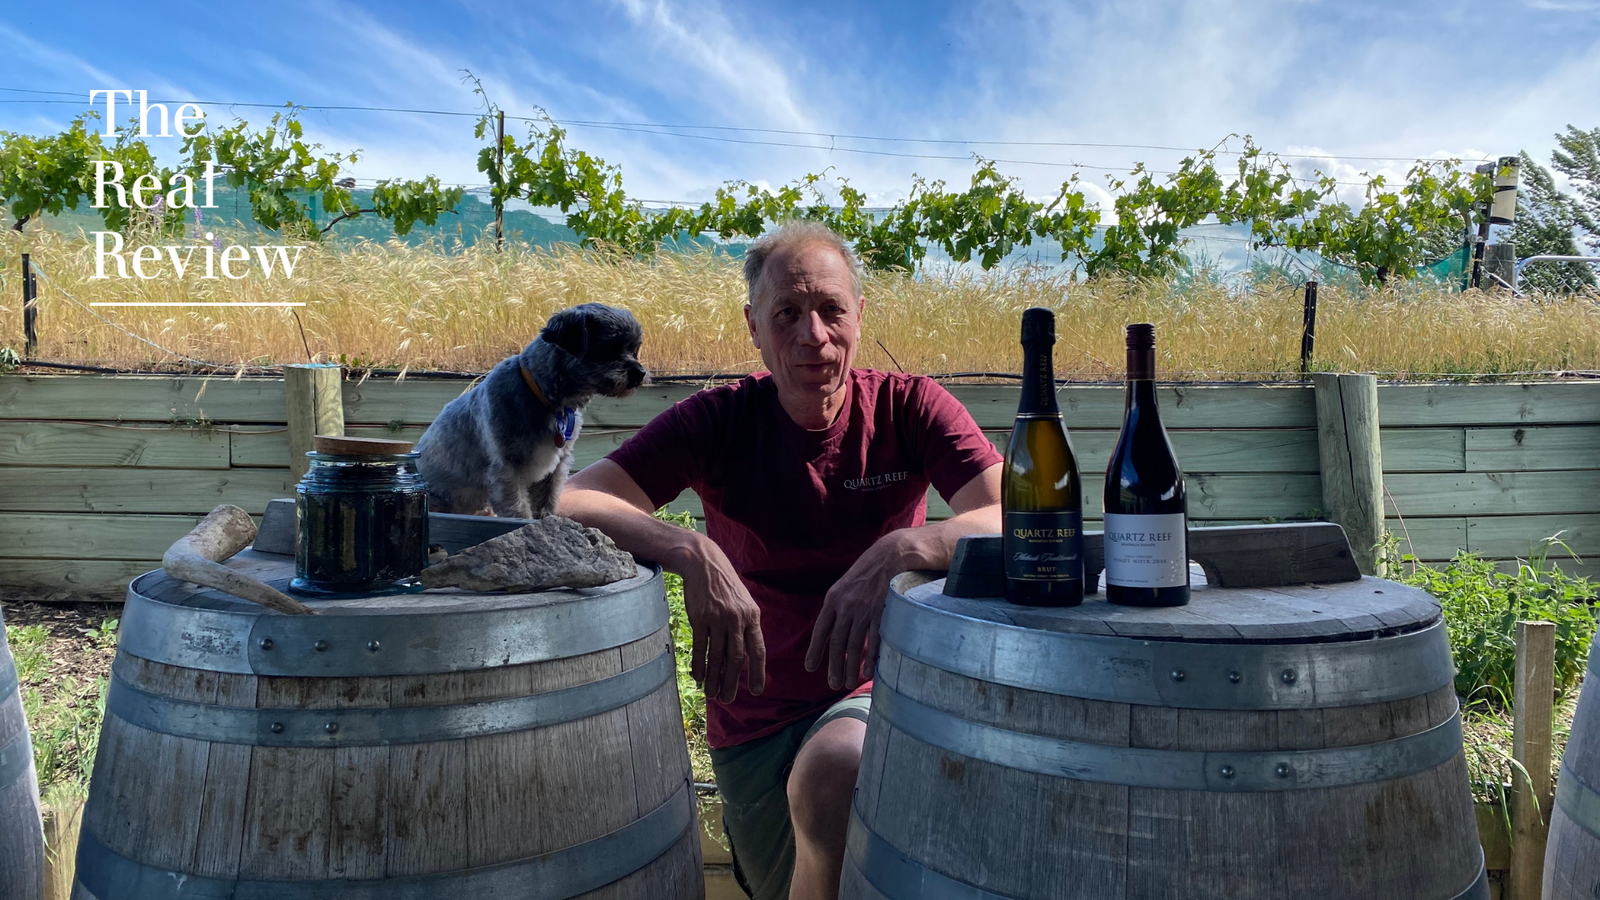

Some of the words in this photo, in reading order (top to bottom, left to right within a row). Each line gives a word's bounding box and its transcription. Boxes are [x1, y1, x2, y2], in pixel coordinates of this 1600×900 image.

[1039, 354, 1048, 372] REEF
[1039, 373, 1049, 406] QUARTZ
[843, 475, 882, 490] QUARTZ
[884, 471, 908, 483] REEF
[1013, 528, 1054, 539] QUARTZ
[1056, 528, 1076, 537] REEF
[1108, 531, 1145, 542] QUARTZ
[1149, 532, 1172, 542] REEF
